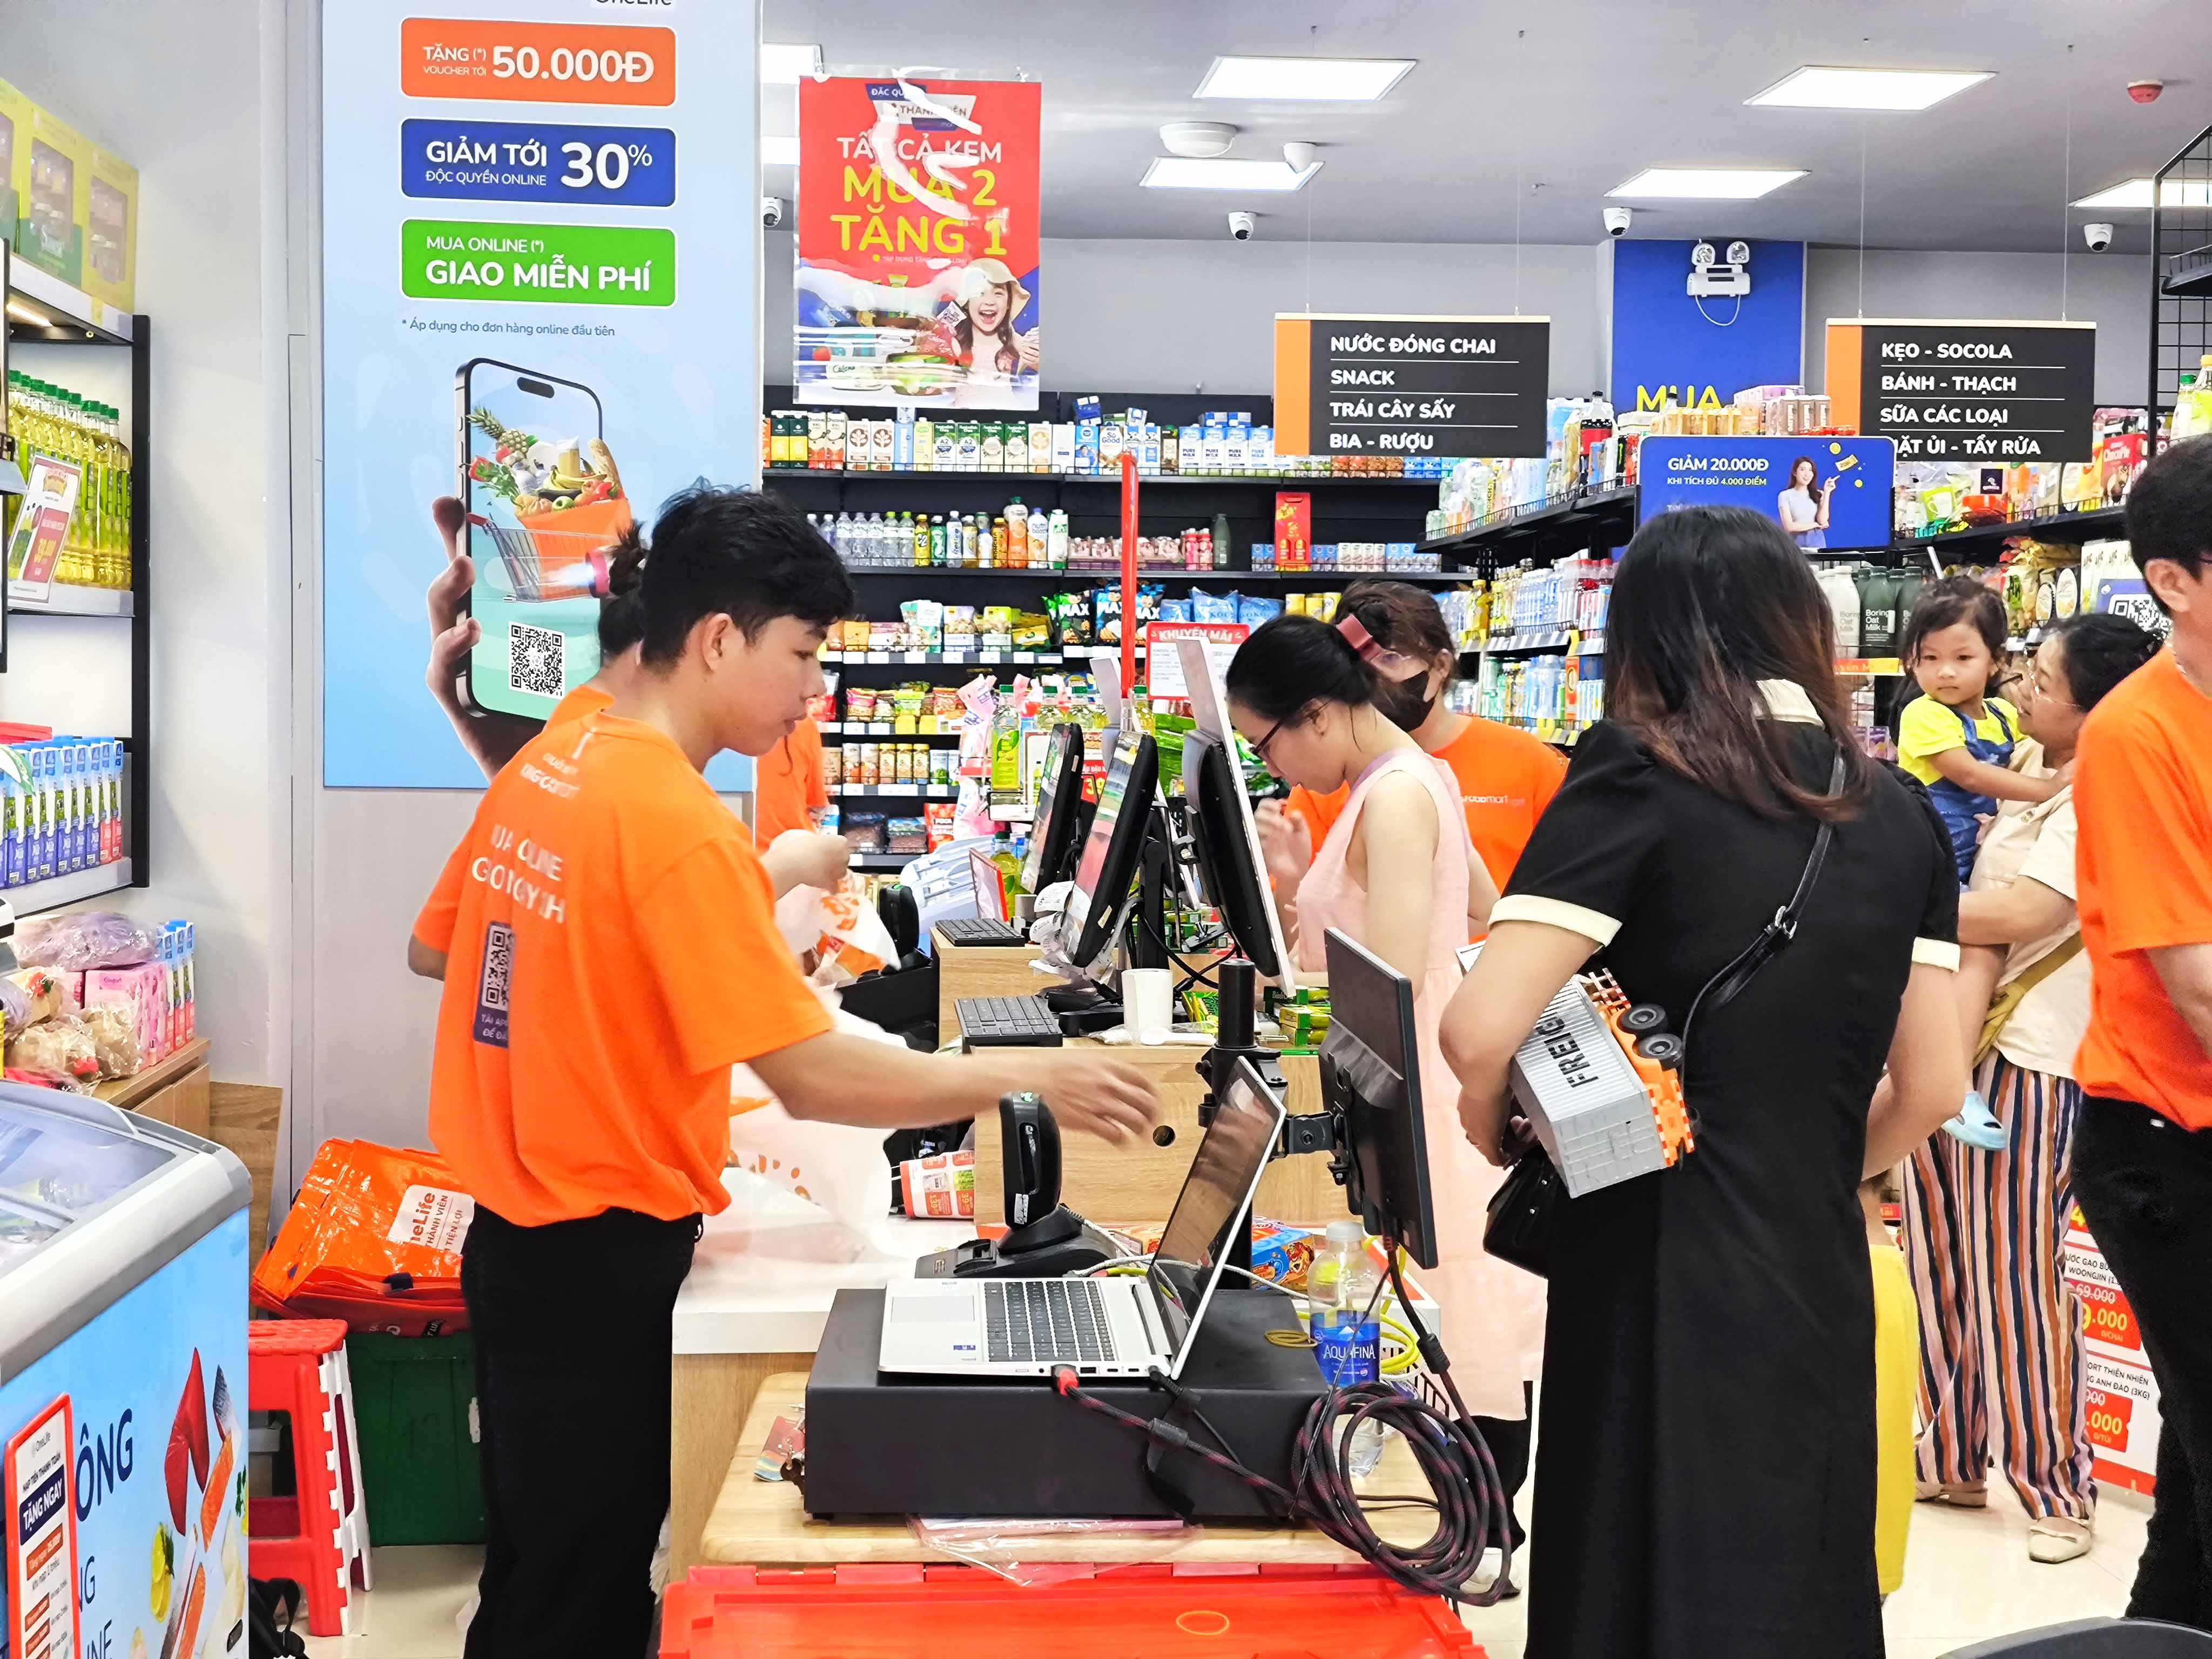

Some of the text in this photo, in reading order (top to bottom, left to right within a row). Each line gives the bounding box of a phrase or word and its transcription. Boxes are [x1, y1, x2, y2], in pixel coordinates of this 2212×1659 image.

[423, 44, 469, 63] TẶNG
[492, 46, 655, 83] 50.000Đ
[423, 65, 487, 76] VOUCHER TỚI
[898, 133, 933, 161] CẢ
[945, 140, 1001, 164] KEM
[427, 137, 653, 188] GIẢM TỚI 30%
[426, 168, 547, 186] ĐỘC QUYỀN ONLINE
[972, 169, 997, 206] 2
[830, 204, 1008, 262] TẶNG 1
[427, 235, 465, 251] MUA
[468, 238, 527, 253] ONLINE
[426, 254, 653, 292] GIAO MIỄN PHÍ
[410, 318, 427, 333] Áp
[429, 320, 457, 334] dụng
[460, 322, 479, 332] cho
[482, 321, 503, 333] đơn
[506, 322, 533, 336] hàng
[536, 324, 569, 335] online
[571, 323, 592, 336] đầu
[595, 325, 615, 337] tiên
[1331, 333, 1496, 354] NƯỚC ĐÓNG CHAI
[1881, 343, 1920, 362] KẸO
[1937, 343, 2013, 359] SOCOLA
[1331, 370, 1395, 385] SNACK
[1881, 372, 1935, 391] BÁNH
[1952, 376, 2016, 395] THẠCH
[1330, 398, 1455, 419] TRÁI CÂY SẤY
[1880, 404, 2008, 427] SỮA CÁC LOẠI
[1330, 434, 1362, 449] BIA
[1380, 432, 1434, 454] RƯỢU
[1927, 436, 1945, 455] ỦI
[1963, 434, 1998, 455] TẨY
[2001, 436, 2041, 455] RỬA
[1668, 454, 1770, 473] GIẢM 20.000Đ
[1667, 475, 1767, 486] KHI TÍCH ĐỦ 4.000 ĐIỂM
[1058, 603, 1090, 617] MAX
[1158, 626, 1232, 642] KHUYẾN MÃI
[436, 1195, 448, 1217] VIÊN
[446, 1226, 458, 1246] TIỆN
[453, 1210, 463, 1224] LỢI
[2069, 1266, 2106, 1282] WOONGJIN
[1323, 1344, 1377, 1361] AQUAFINA
[2087, 1361, 2149, 1386] ORT THIÊN NHIÊN
[2096, 1378, 2112, 1387] ANH
[2131, 1387, 2150, 1401] (3KG)
[23, 1501, 43, 1532] TẶNG
[44, 1478, 63, 1512] NGAY
